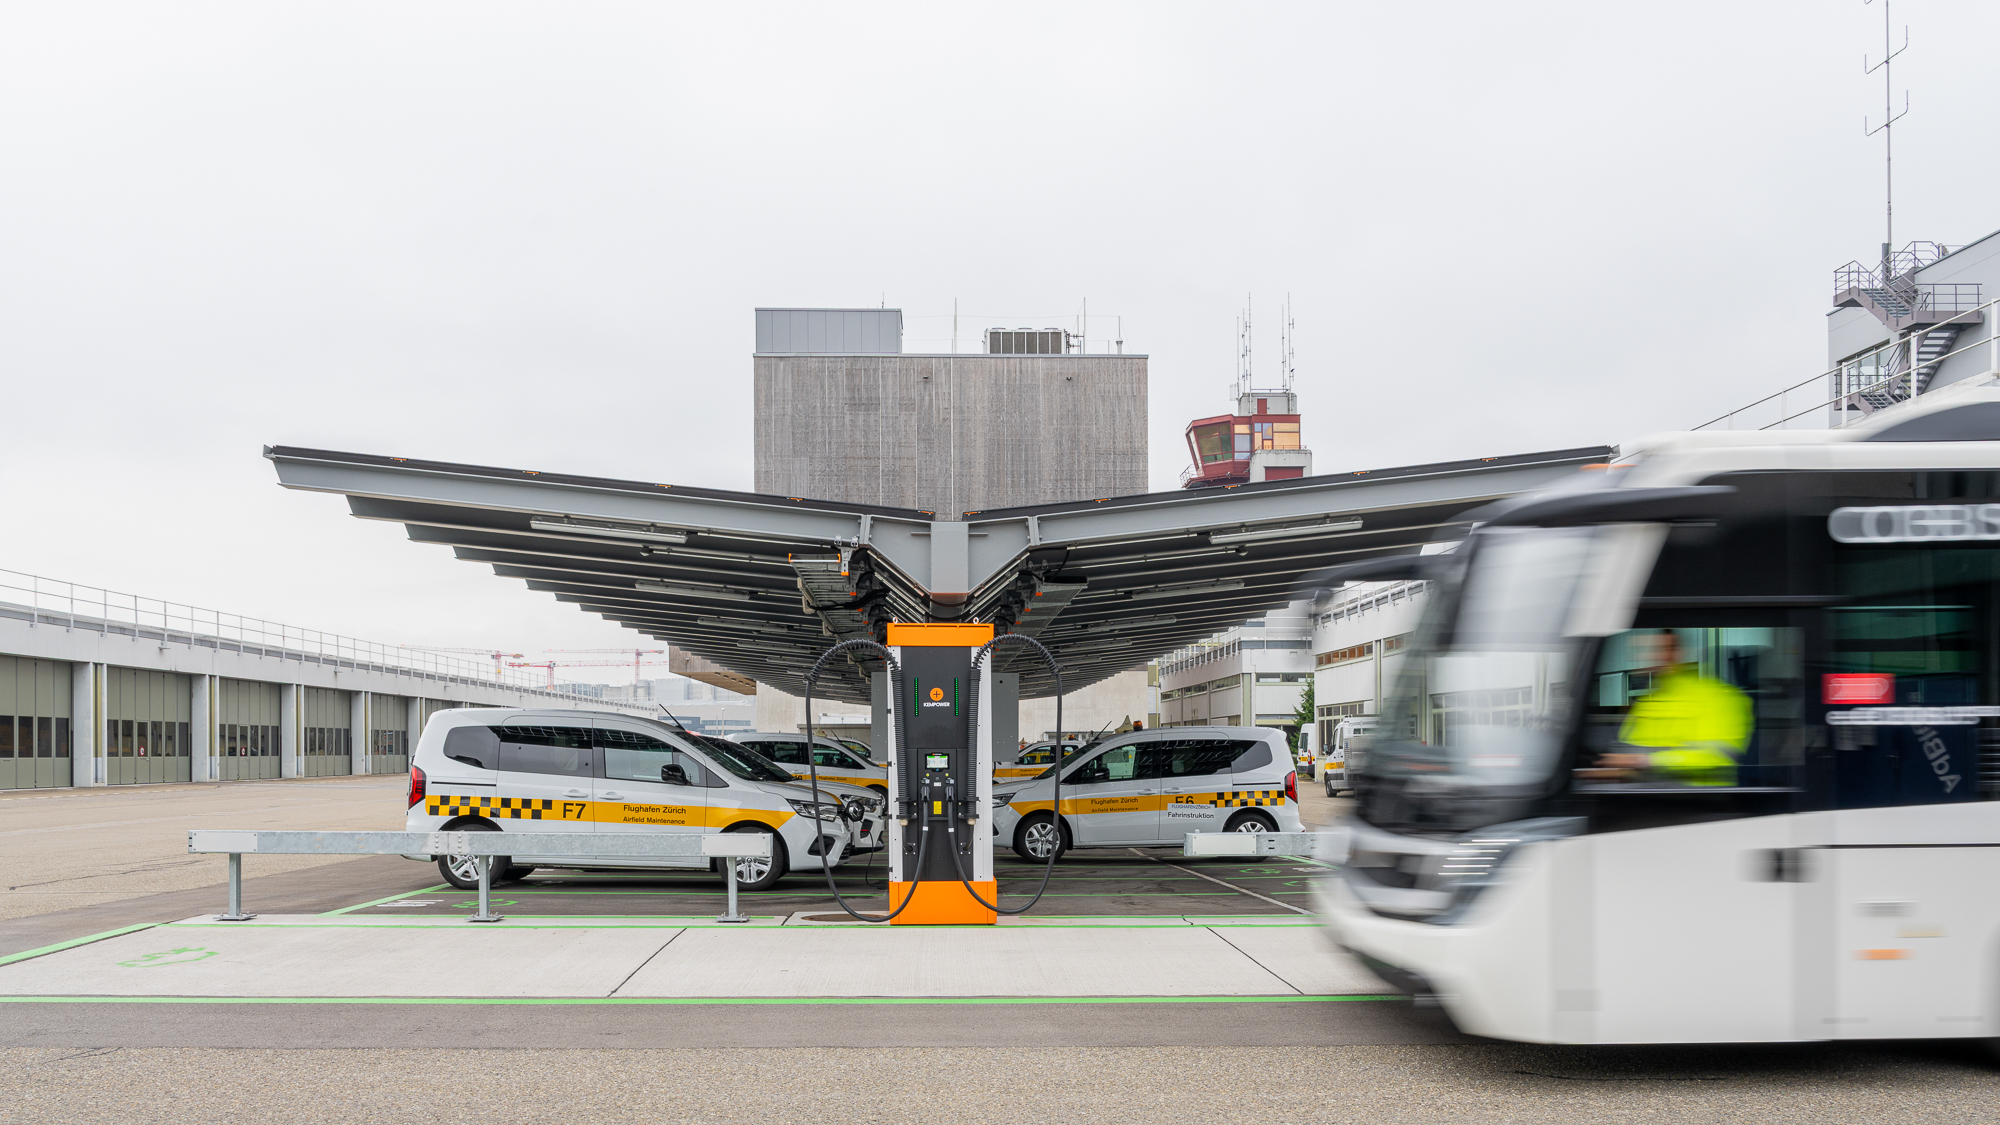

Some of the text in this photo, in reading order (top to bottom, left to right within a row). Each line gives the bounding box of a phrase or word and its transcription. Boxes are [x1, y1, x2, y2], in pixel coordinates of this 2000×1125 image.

[562, 803, 586, 819] F7
[623, 805, 686, 814] Flughafen Zürich
[646, 817, 686, 825] Maintenance
